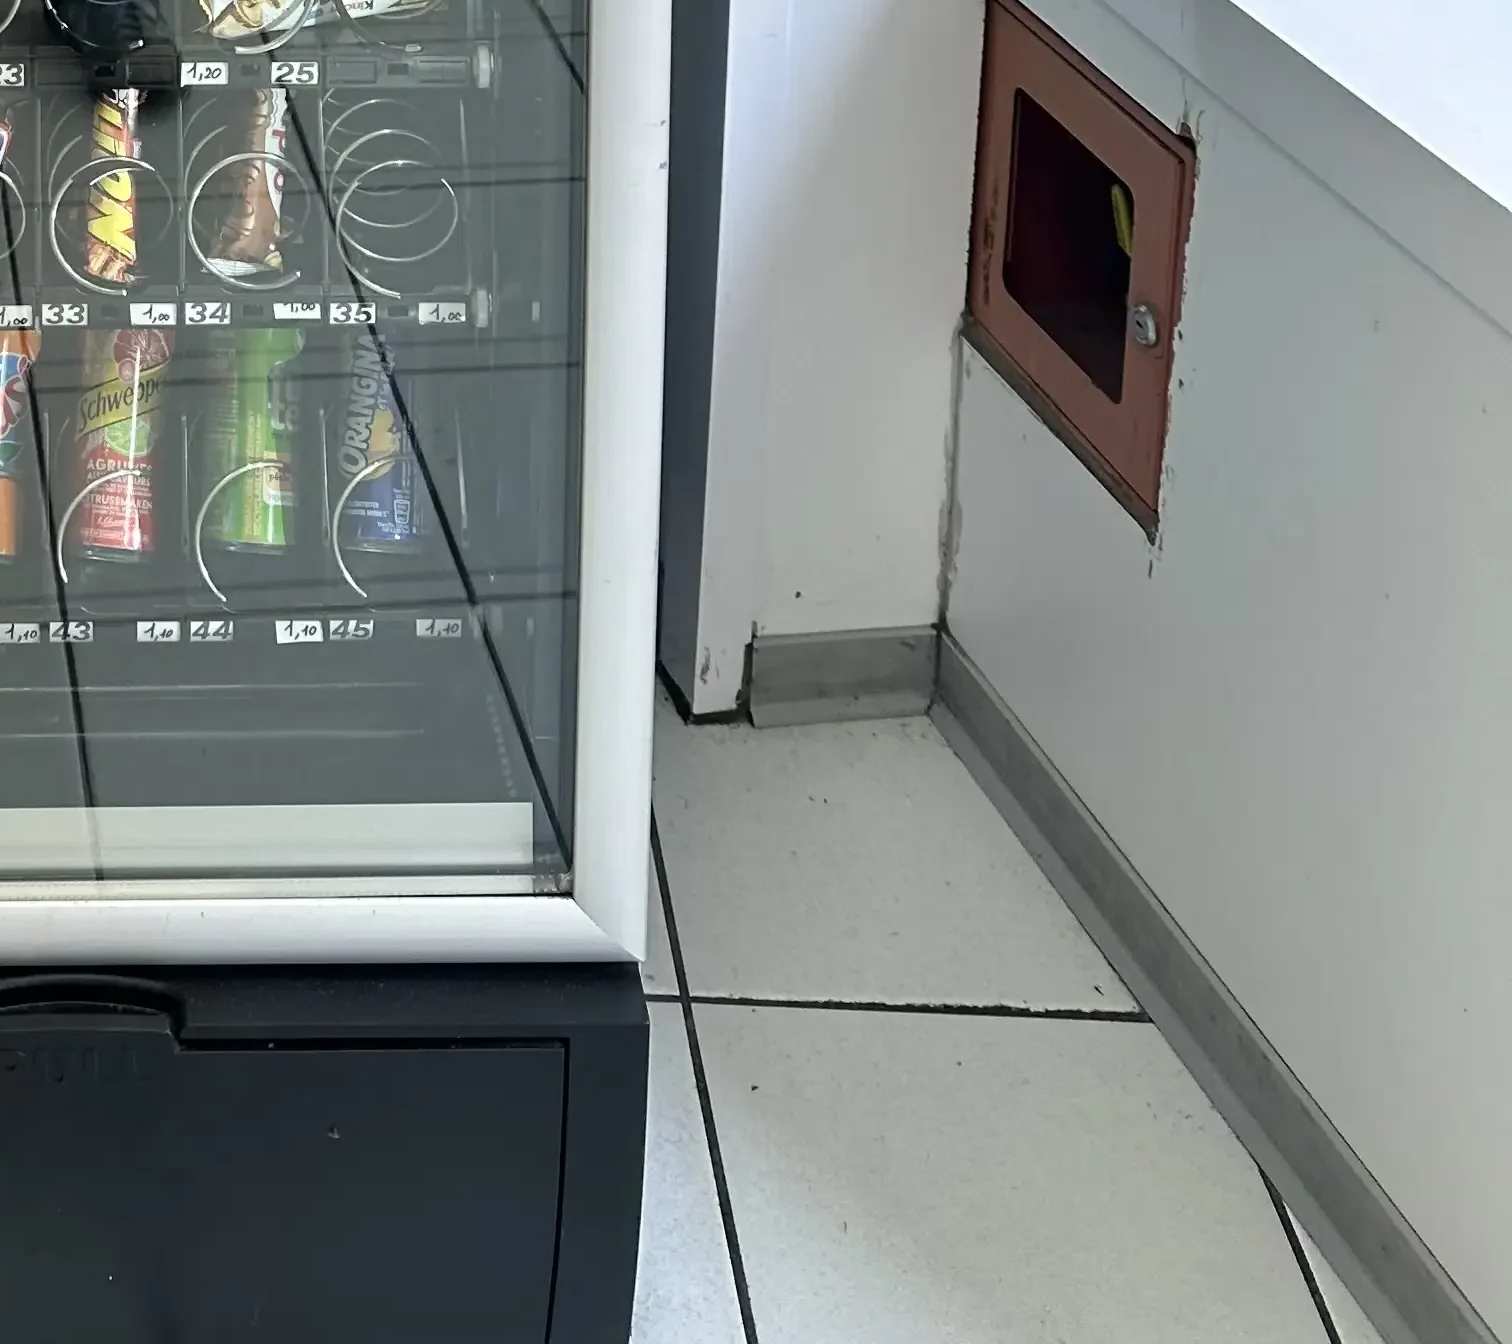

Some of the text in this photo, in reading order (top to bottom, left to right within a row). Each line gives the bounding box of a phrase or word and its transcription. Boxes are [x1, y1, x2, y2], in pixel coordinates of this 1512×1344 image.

[276, 62, 315, 83] 25
[46, 305, 85, 324] 33
[189, 303, 229, 323] 34
[333, 303, 373, 323] 35
[52, 622, 91, 640] 43
[192, 621, 232, 640] 44
[332, 621, 373, 639] 45
